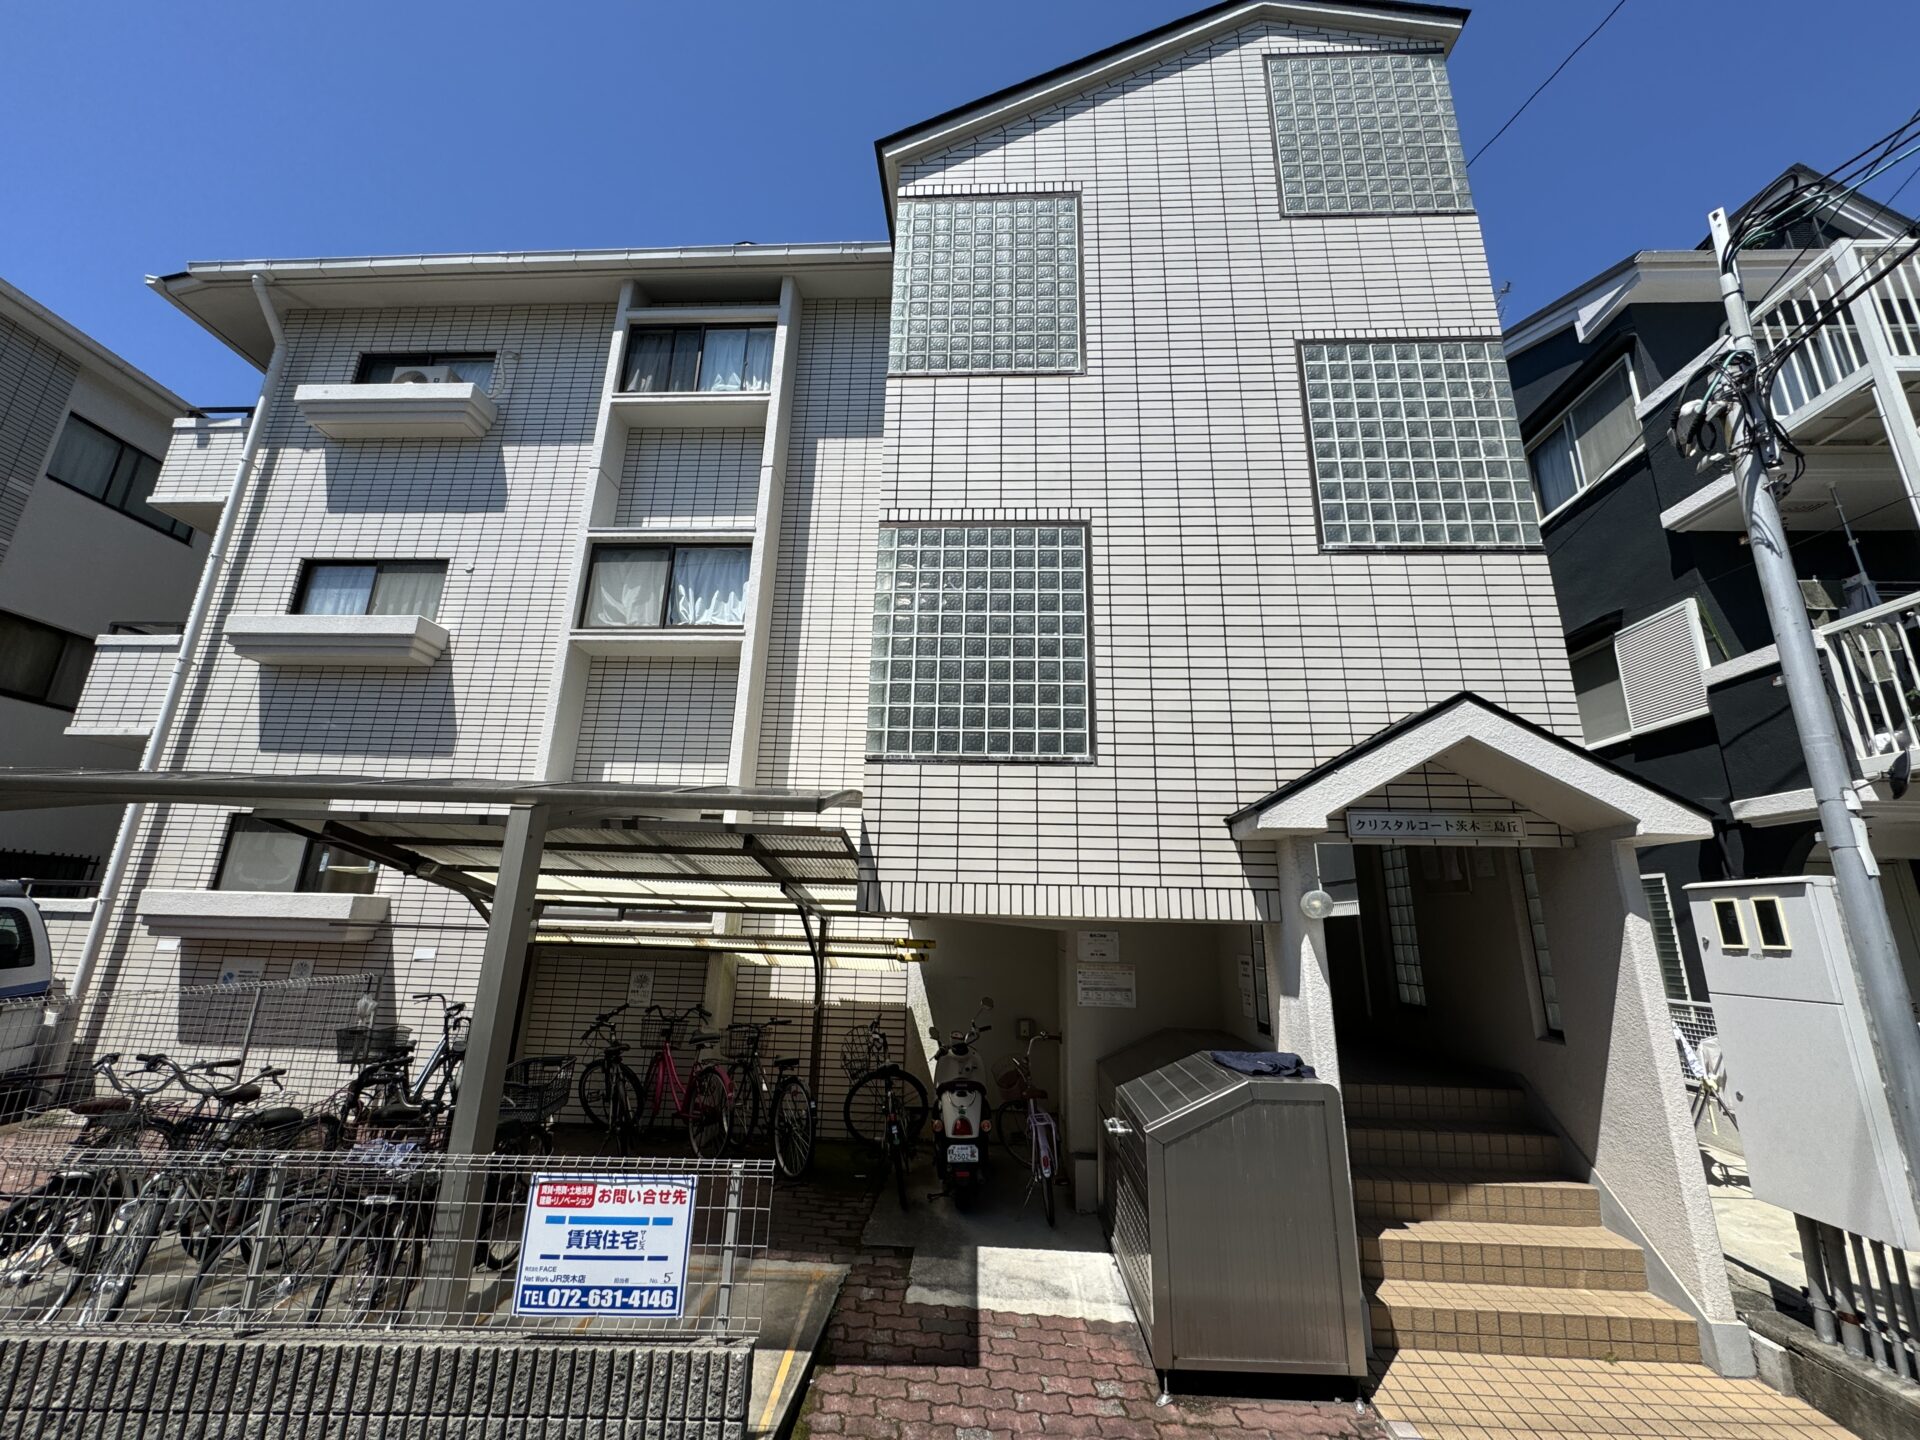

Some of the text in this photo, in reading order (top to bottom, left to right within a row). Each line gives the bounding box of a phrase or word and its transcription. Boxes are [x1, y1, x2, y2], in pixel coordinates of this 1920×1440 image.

[1355, 819, 1519, 833] クリスタルコート茨木三島丘
[598, 1189, 687, 1205] お問い合せ先
[566, 1229, 639, 1250] 賃貸住宅
[550, 1275, 586, 1284] JR茨木店
[663, 1271, 673, 1284] 5
[524, 1288, 674, 1309] TEL 072-631-4146
